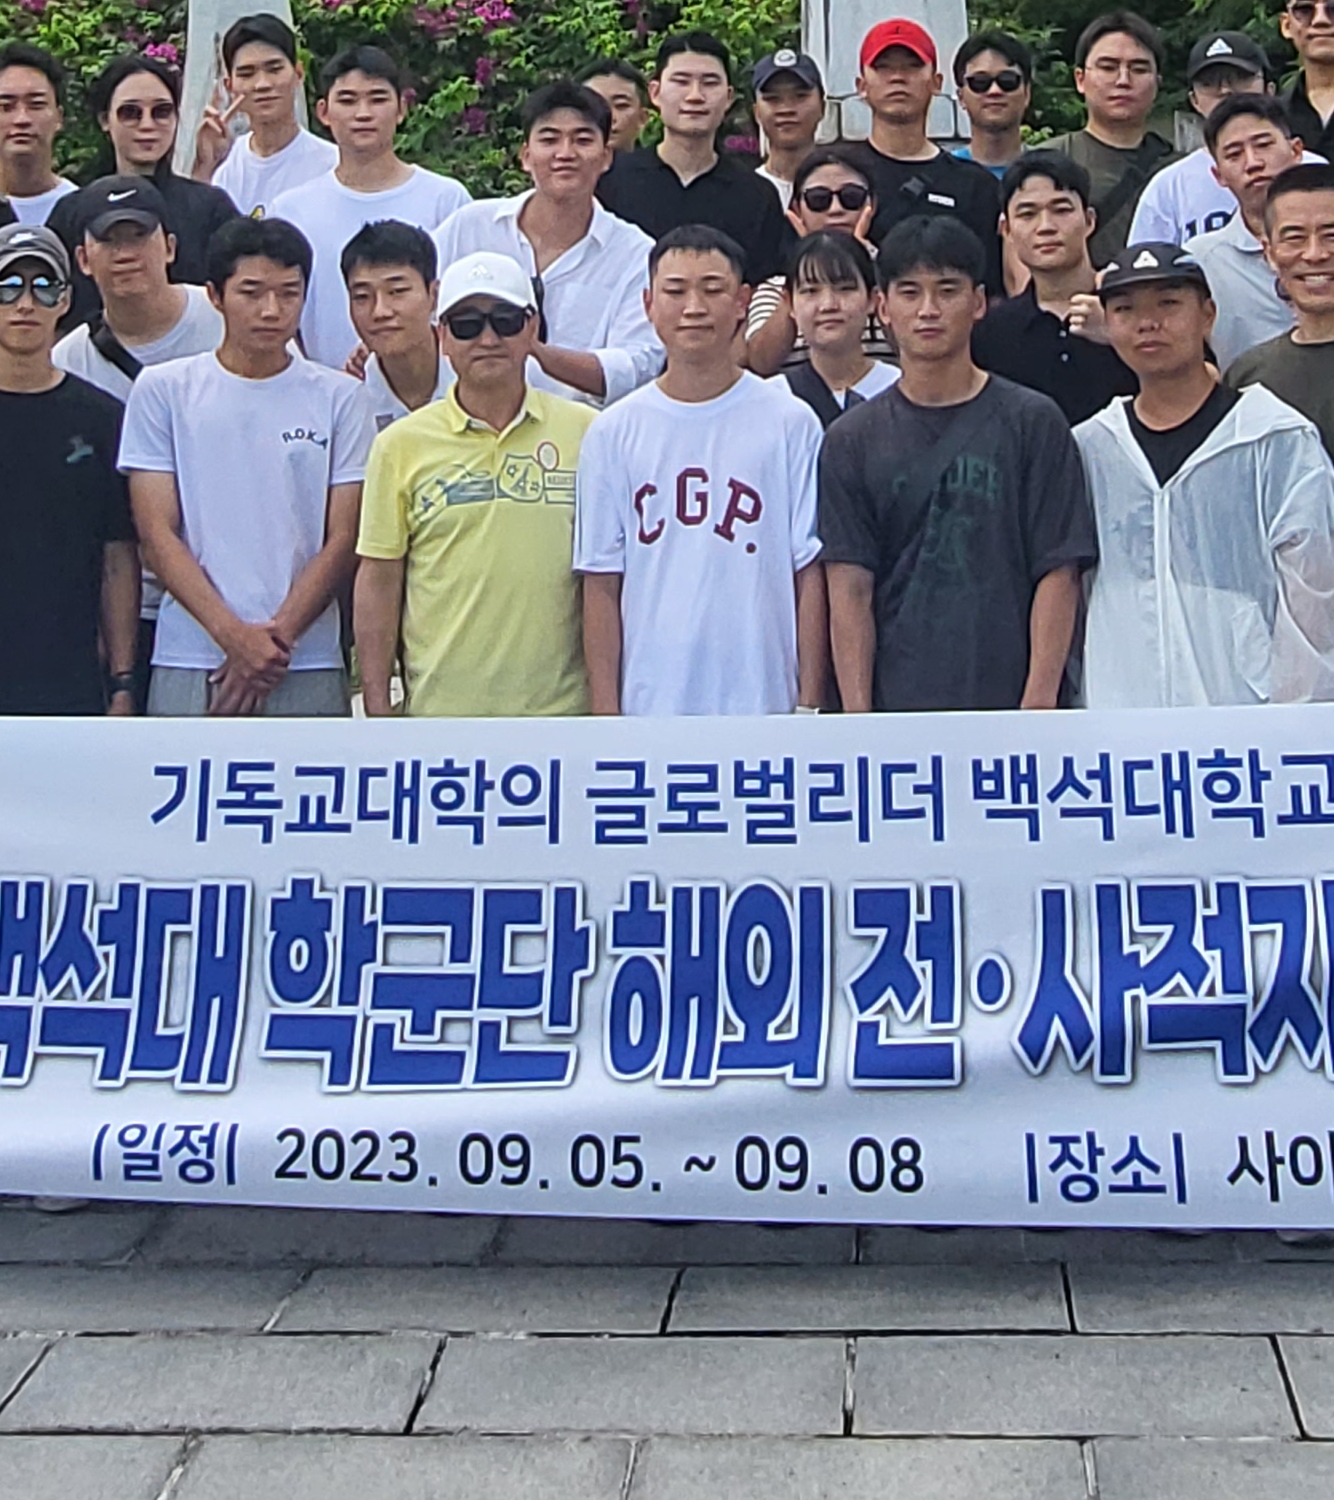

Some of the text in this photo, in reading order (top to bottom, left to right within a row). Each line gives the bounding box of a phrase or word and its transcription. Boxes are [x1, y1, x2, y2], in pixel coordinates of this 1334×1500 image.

[151, 758, 561, 846] 기독교대학의
[586, 755, 945, 845] 글로벌리더
[263, 876, 597, 1092] 학군단
[607, 876, 834, 1088] 해외
[274, 1127, 438, 1188] 2023.
[458, 1132, 550, 1190] 09.
[570, 1133, 662, 1193] 05.
[848, 1136, 924, 1194] 08
